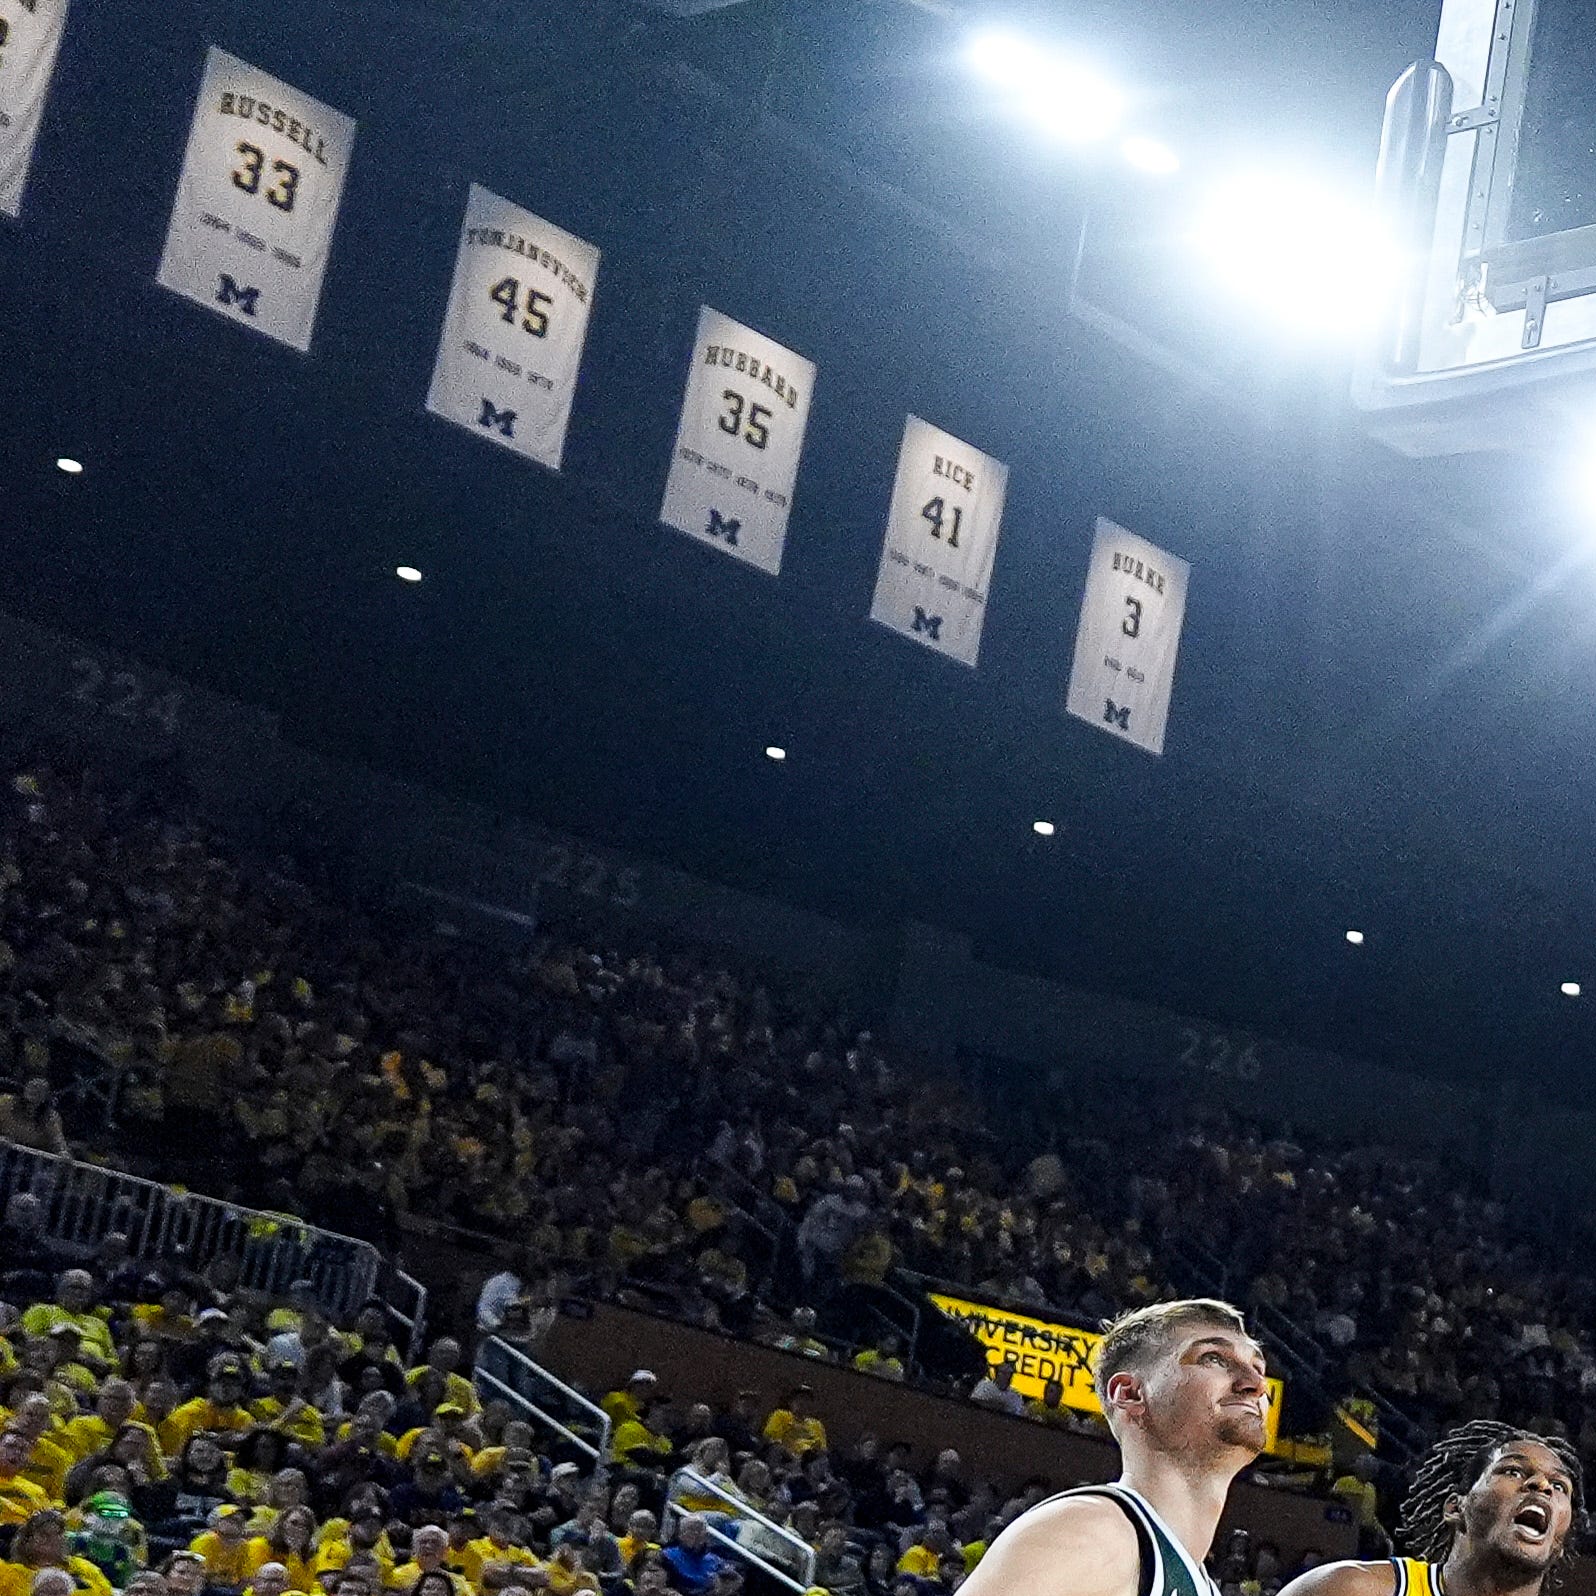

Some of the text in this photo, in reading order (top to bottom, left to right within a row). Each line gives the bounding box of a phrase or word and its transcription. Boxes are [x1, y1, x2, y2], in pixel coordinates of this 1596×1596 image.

[219, 91, 328, 168] RUSSELL
[230, 140, 300, 213] 33
[215, 273, 260, 316] M
[488, 275, 552, 339] 45
[704, 344, 800, 409] HUBBARD
[477, 398, 518, 439] M
[718, 389, 774, 450] 35
[932, 454, 975, 492] RICE
[705, 509, 742, 546] M
[922, 495, 963, 549] 41
[911, 605, 944, 641] M
[1122, 595, 1142, 639] 3
[1103, 697, 1131, 731] M
